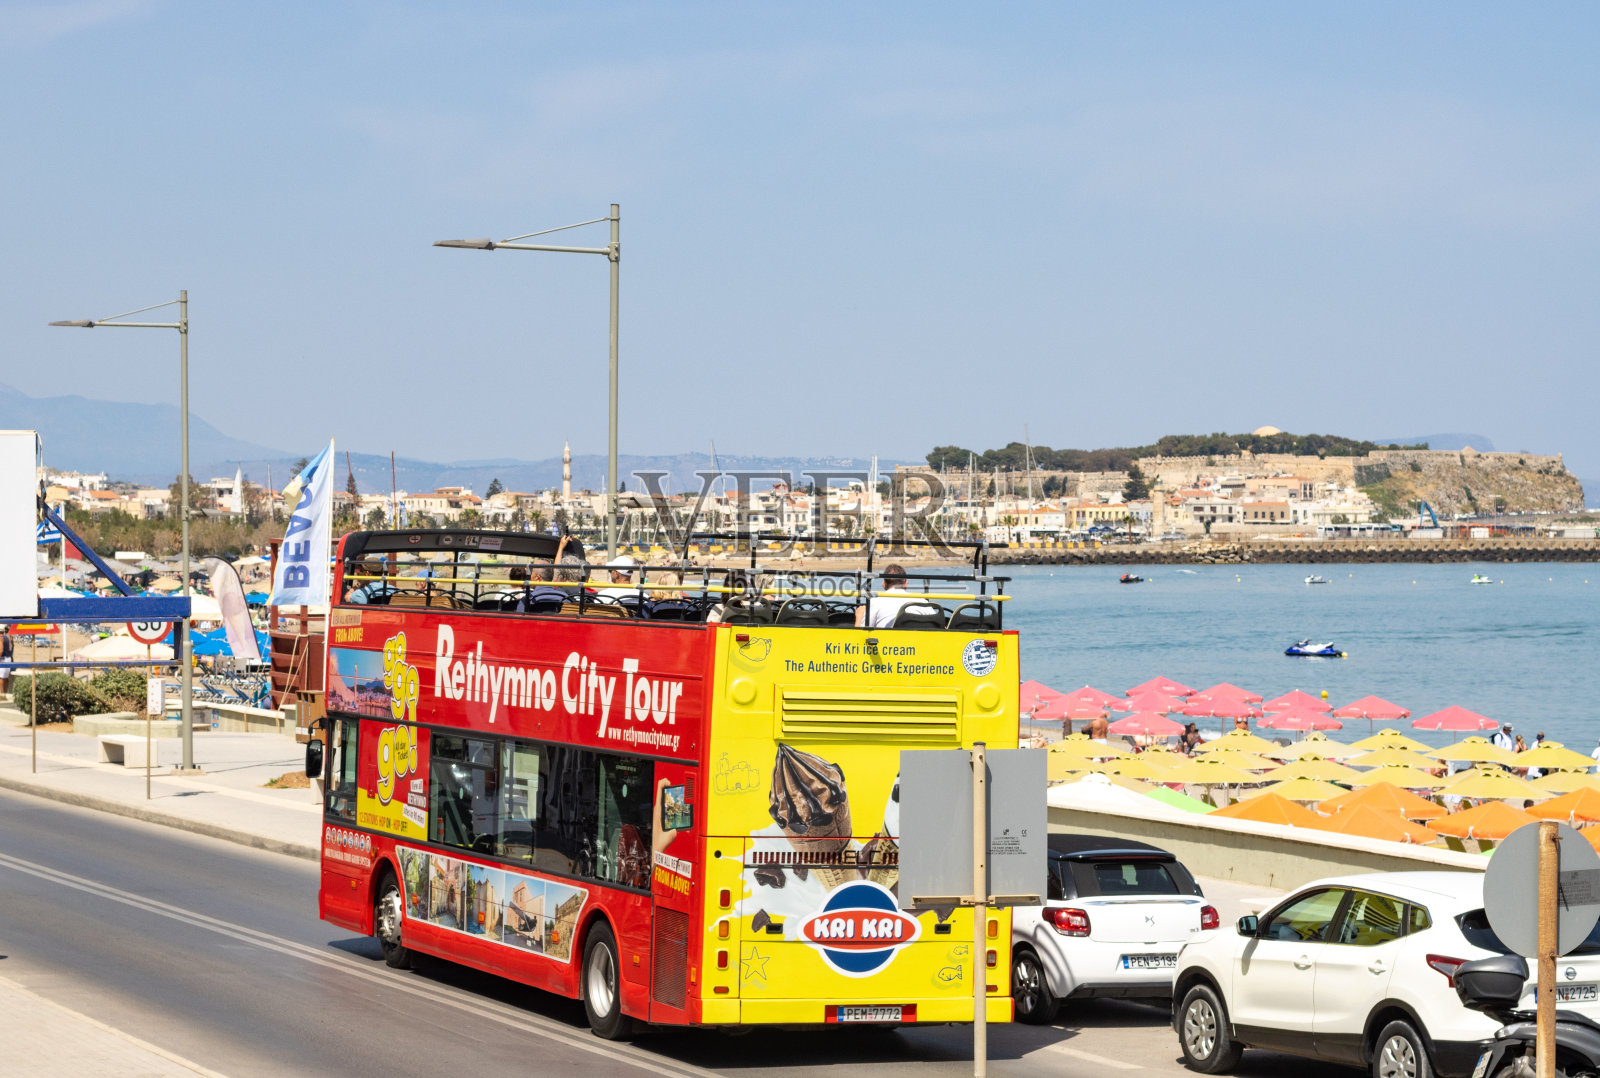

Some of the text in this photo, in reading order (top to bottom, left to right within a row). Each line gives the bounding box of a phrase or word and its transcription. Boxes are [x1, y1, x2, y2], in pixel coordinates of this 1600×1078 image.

[825, 642, 916, 656] Kri Kri ice cream
[785, 659, 955, 676] The Authentic Greek Experience
[434, 624, 683, 737] Rethymno City Tour
[655, 866, 670, 887] FROM
[814, 918, 903, 939] KRI KRI
